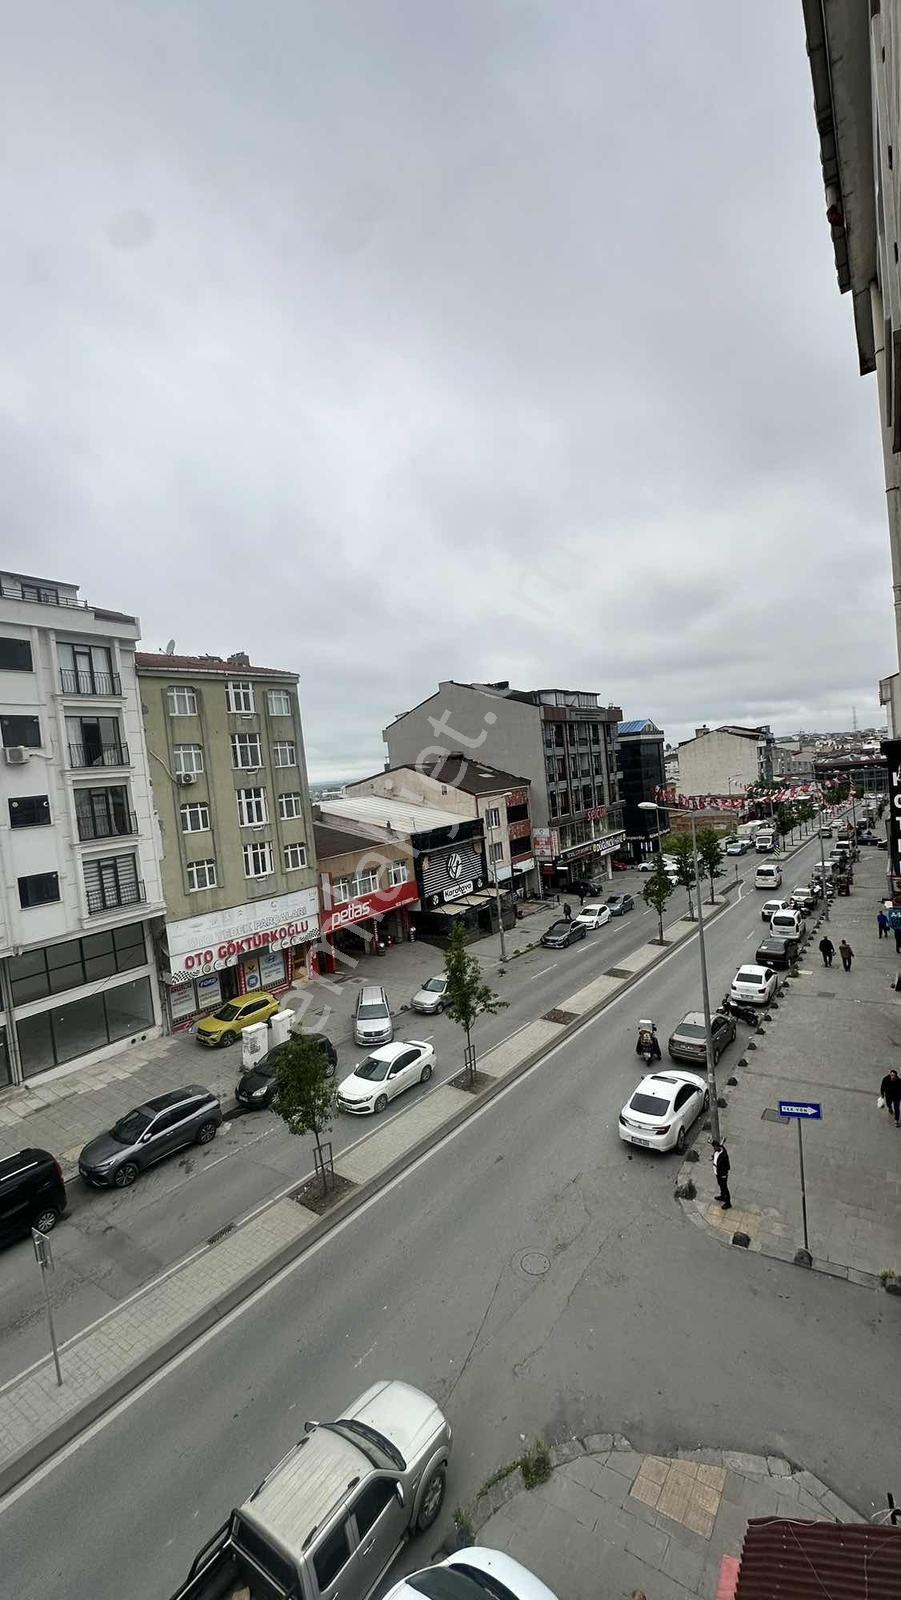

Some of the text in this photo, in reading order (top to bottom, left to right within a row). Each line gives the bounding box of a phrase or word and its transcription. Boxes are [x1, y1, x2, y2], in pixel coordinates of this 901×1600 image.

[331, 900, 371, 930] petlas
[184, 919, 309, 970] OTO GÖKTÜRKOĞLU
